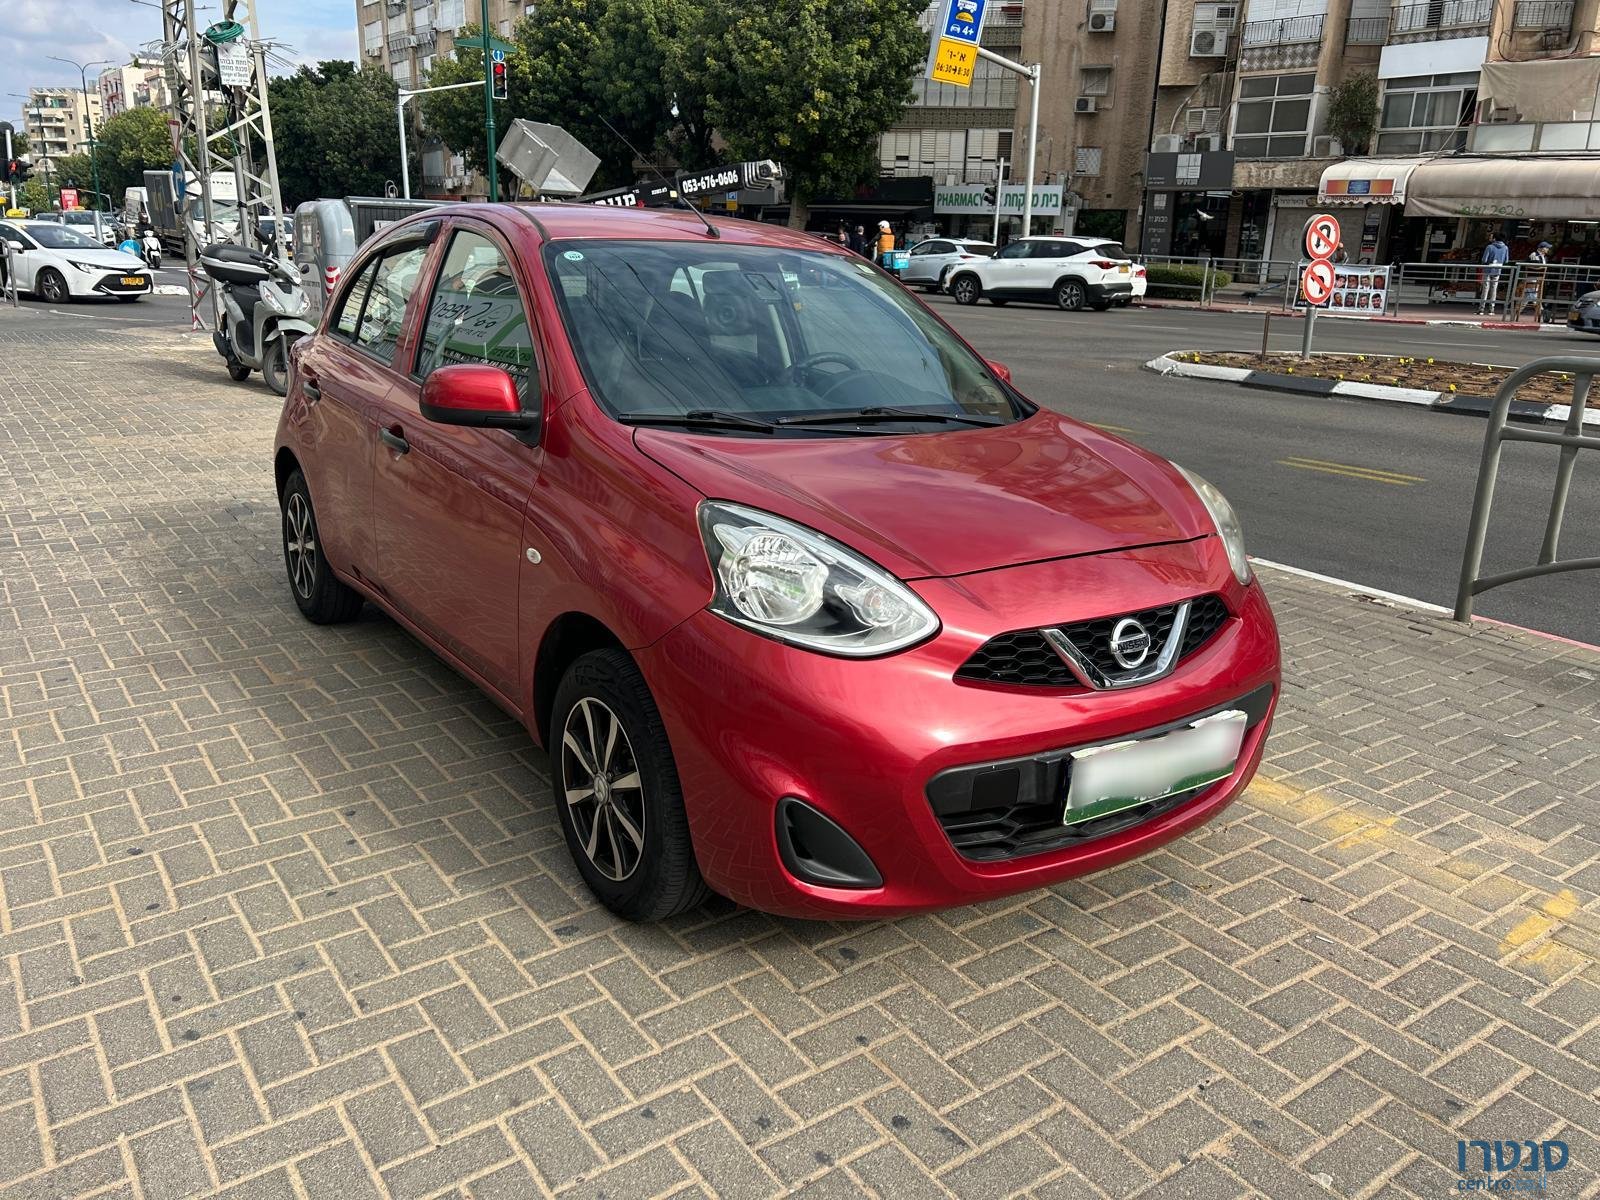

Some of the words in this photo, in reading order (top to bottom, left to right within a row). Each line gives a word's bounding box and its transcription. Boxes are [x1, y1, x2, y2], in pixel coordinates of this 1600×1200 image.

[962, 25, 974, 36] 4+
[682, 170, 739, 194] 053-676-0606
[936, 193, 984, 207] PHARMACY
[1003, 193, 1039, 212] מקחת
[1040, 193, 1059, 208] בית
